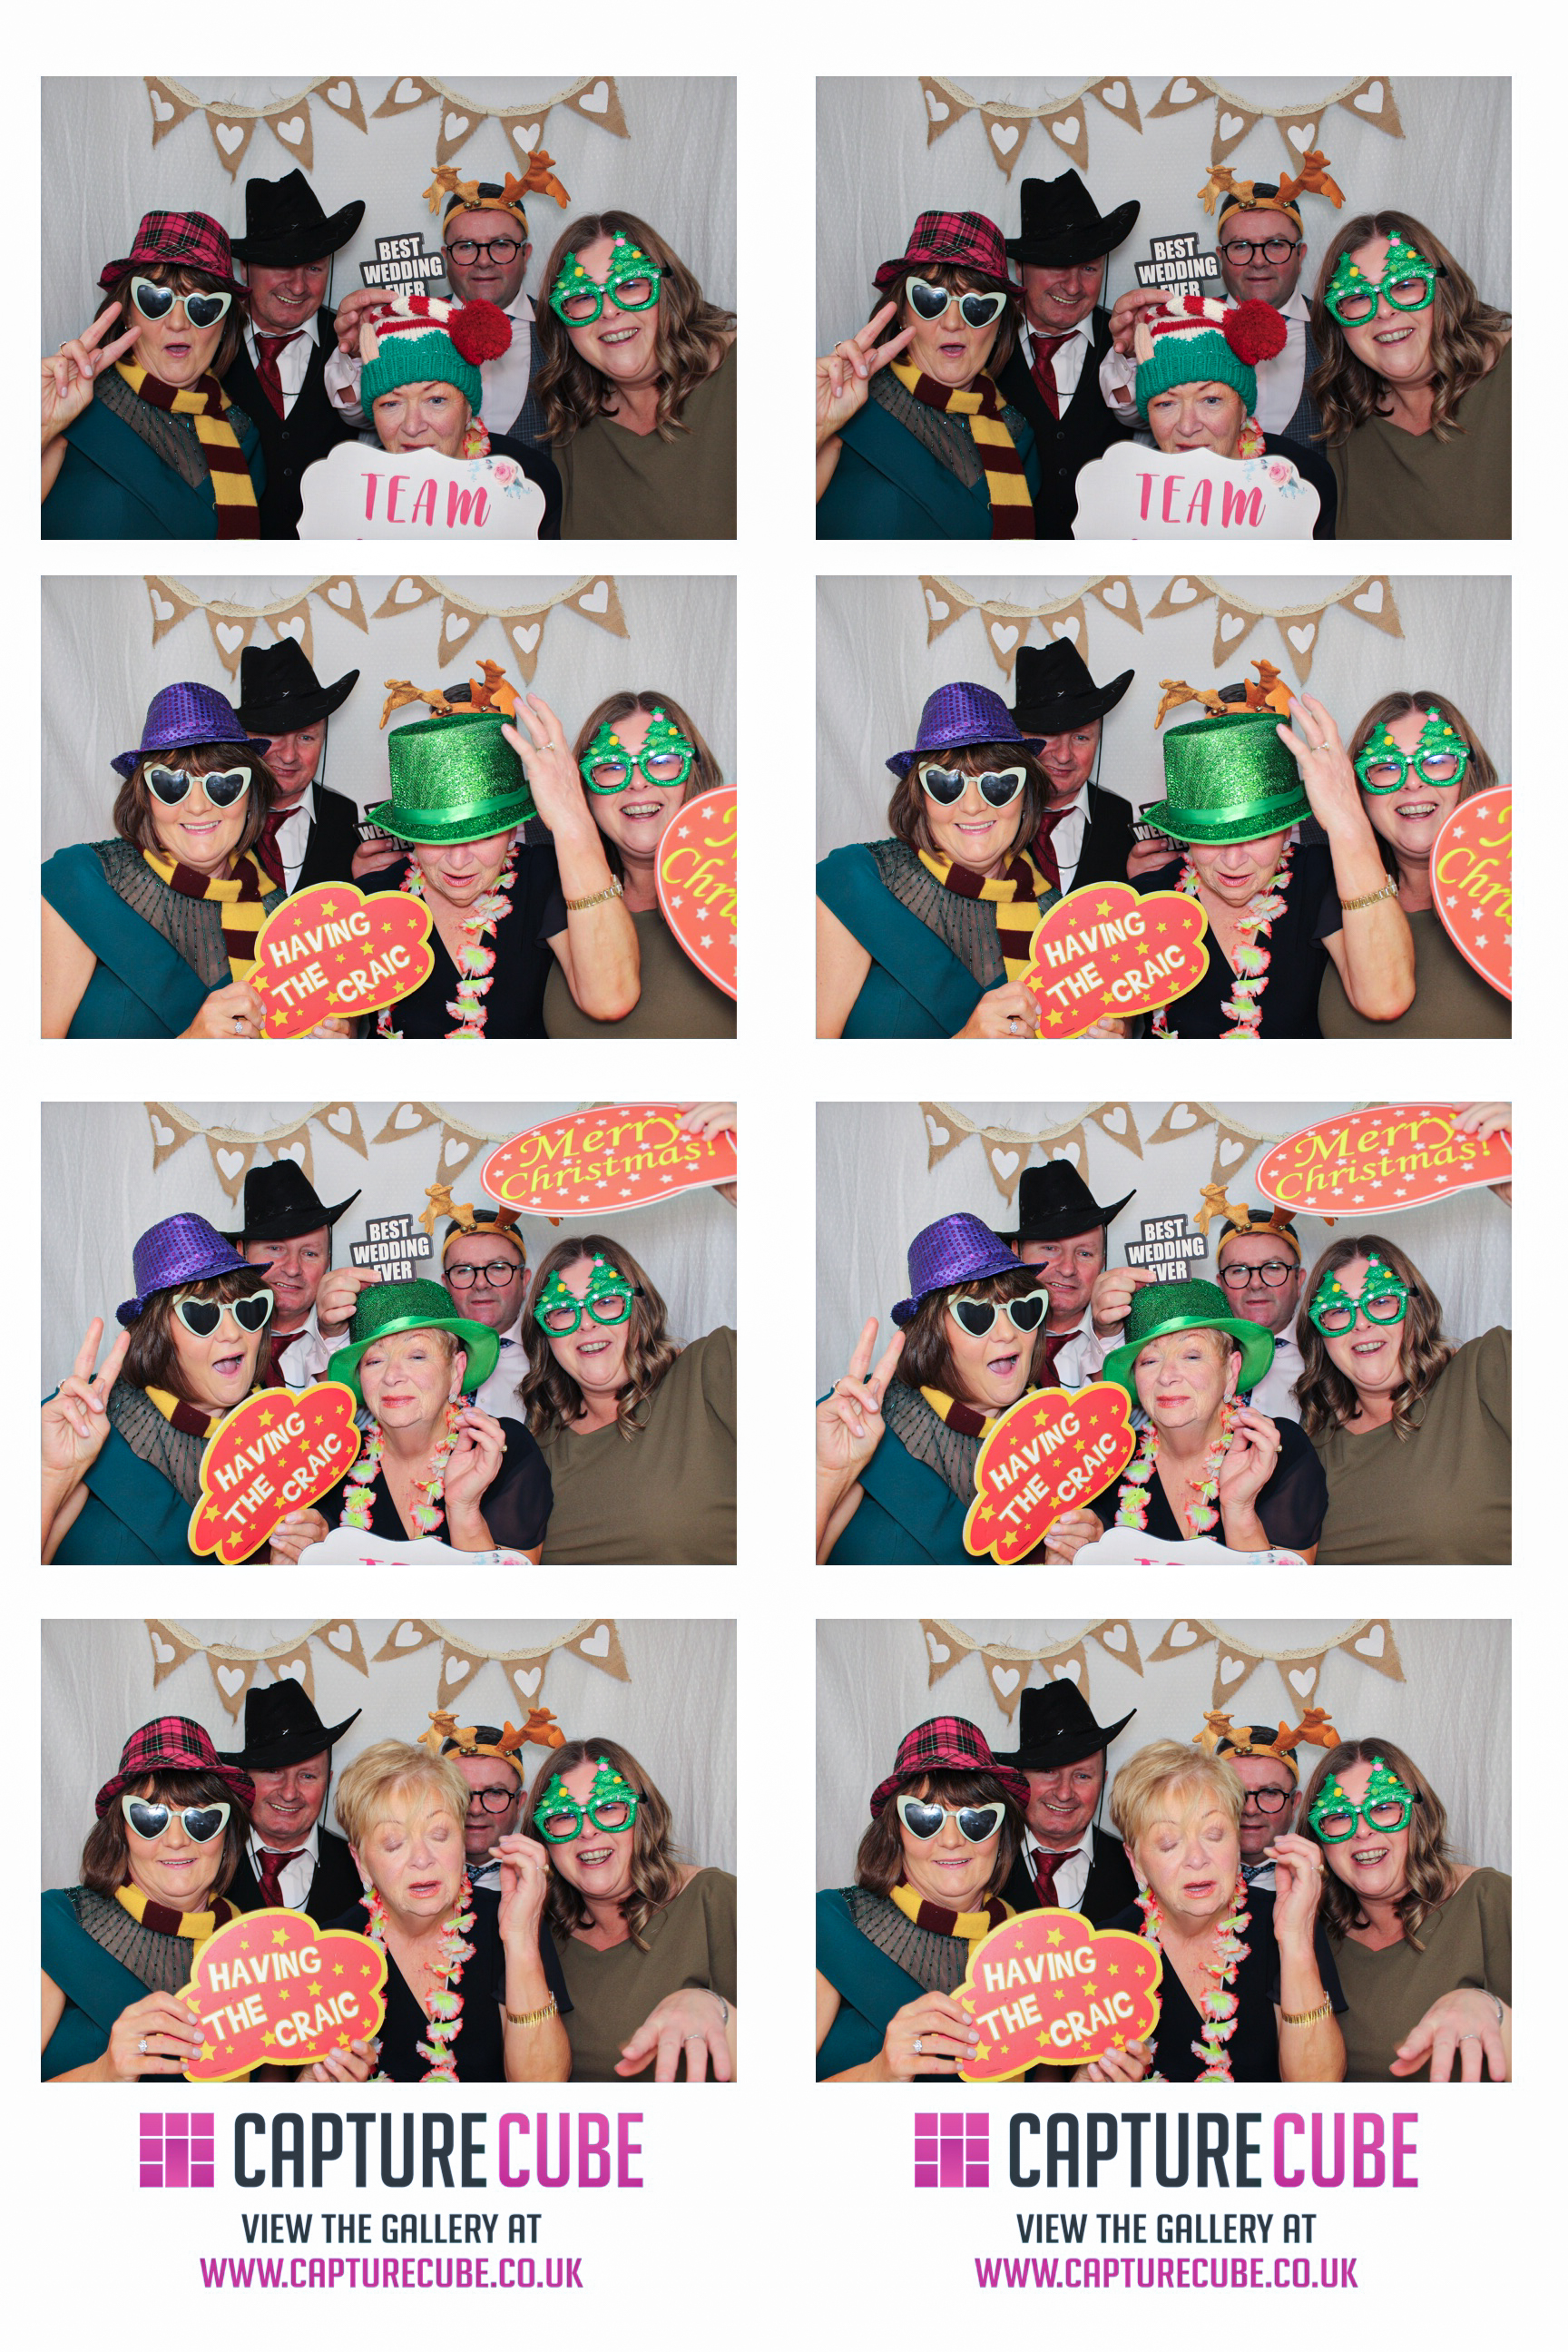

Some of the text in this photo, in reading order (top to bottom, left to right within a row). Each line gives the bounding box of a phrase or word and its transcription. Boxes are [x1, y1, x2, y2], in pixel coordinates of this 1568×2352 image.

[363, 256, 443, 285] WEDDING
[378, 237, 420, 261] BEST
[1138, 256, 1218, 285] WEDDING
[1153, 237, 1195, 261] BEST
[361, 473, 491, 528] TEAM
[1136, 473, 1266, 528] TEAM
[268, 911, 370, 968] HAVING
[1043, 911, 1145, 968] HAVING
[270, 945, 410, 1007] THE CRAIC
[1045, 945, 1185, 1007] THE CRAIC
[519, 1113, 683, 1168] Merry
[1294, 1113, 1458, 1168] Merry
[501, 1141, 716, 1200] Christmas!
[1276, 1141, 1491, 1200] Christmas!
[353, 1237, 430, 1265] WEDDING
[369, 1218, 409, 1242] BEST
[1128, 1237, 1205, 1265] WEDDING
[1144, 1218, 1184, 1242] BEST
[213, 1412, 305, 1493] HAVING
[222, 1433, 342, 1524] THE CRAIC
[988, 1412, 1080, 1493] HAVING
[997, 1433, 1117, 1524] THE CRAIC
[208, 1946, 322, 1993] HAVING
[983, 1946, 1097, 1993] HAVING
[201, 1991, 359, 2047] THE CRAIC
[975, 1991, 1134, 2047] THE CRAIC
